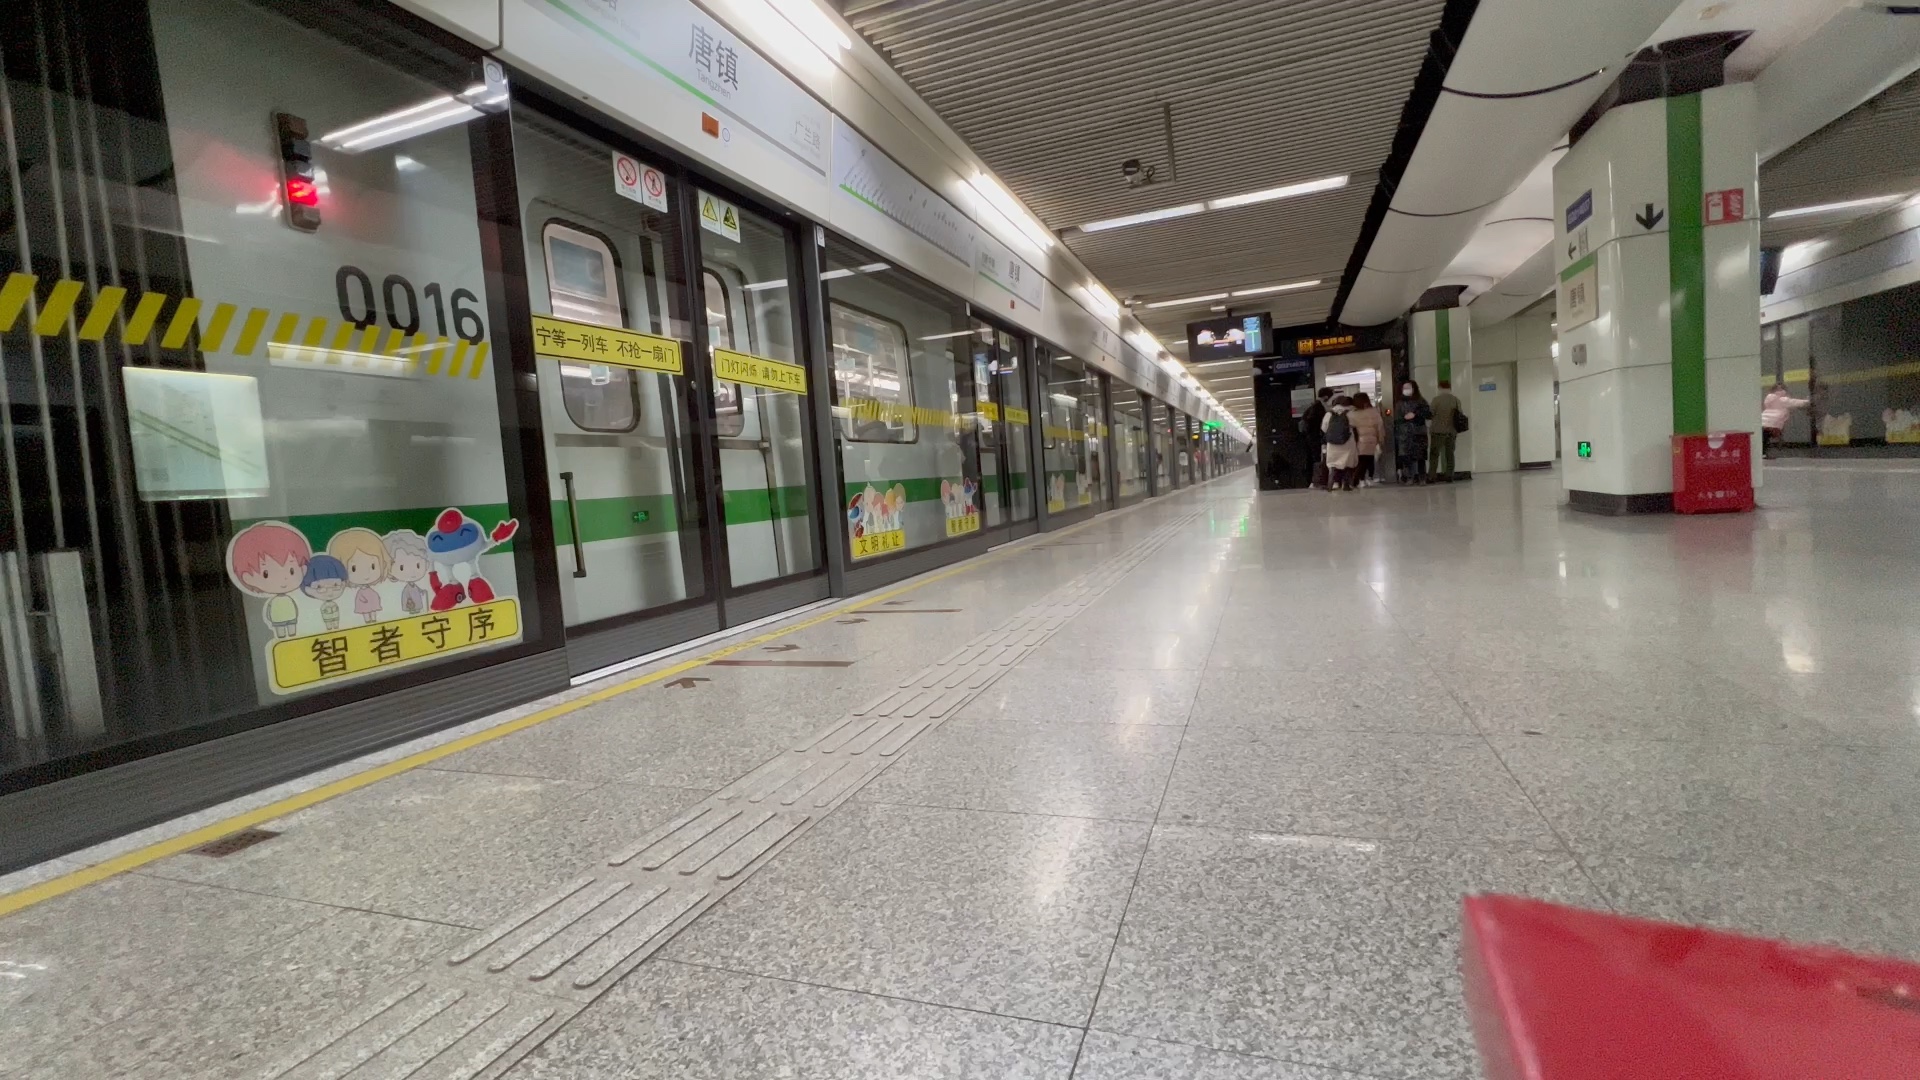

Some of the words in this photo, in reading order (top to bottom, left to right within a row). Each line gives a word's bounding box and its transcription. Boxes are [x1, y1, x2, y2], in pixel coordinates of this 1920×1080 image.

[689, 23, 738, 91] 唐镇
[336, 265, 484, 345] 0016
[536, 326, 608, 354] 宁等一列车
[615, 339, 675, 364] 不抢一扇门
[721, 358, 757, 377] 门灯闪烁
[762, 366, 800, 387] 请勿上下车
[860, 531, 899, 554] 文明礼让
[311, 607, 495, 677] 智者守序
